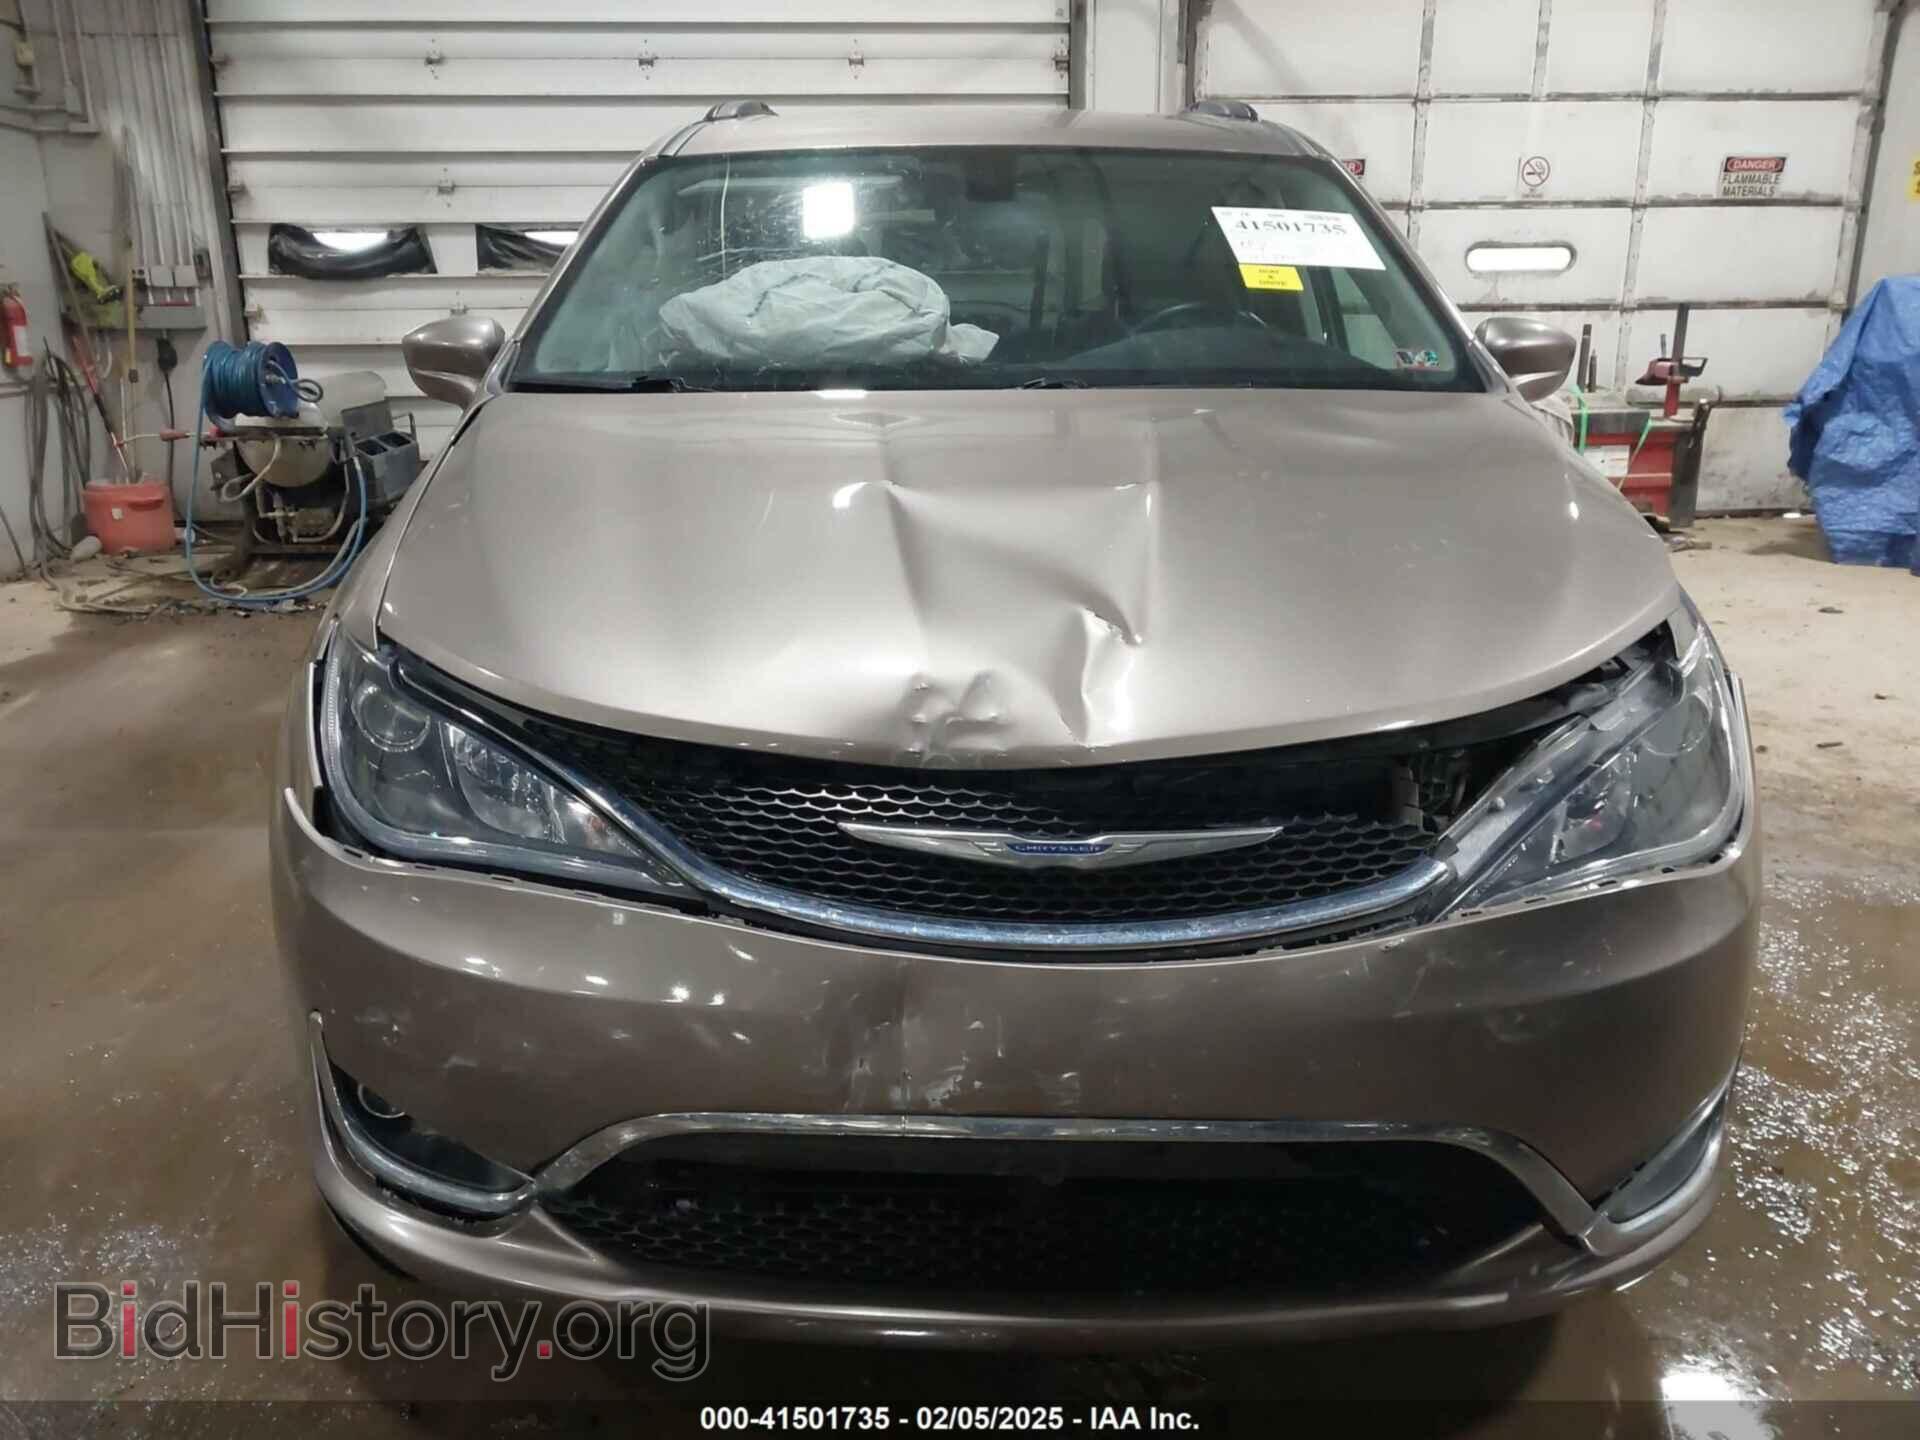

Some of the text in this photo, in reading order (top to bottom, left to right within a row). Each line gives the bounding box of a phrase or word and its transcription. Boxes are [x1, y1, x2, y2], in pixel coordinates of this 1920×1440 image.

[1733, 159, 1777, 169] DANGER
[1722, 174, 1780, 185] FLAMMABLE
[1722, 186, 1775, 197] MATERIALS
[1235, 219, 1348, 235] 41501735
[1014, 844, 1102, 853] CHRYSLER
